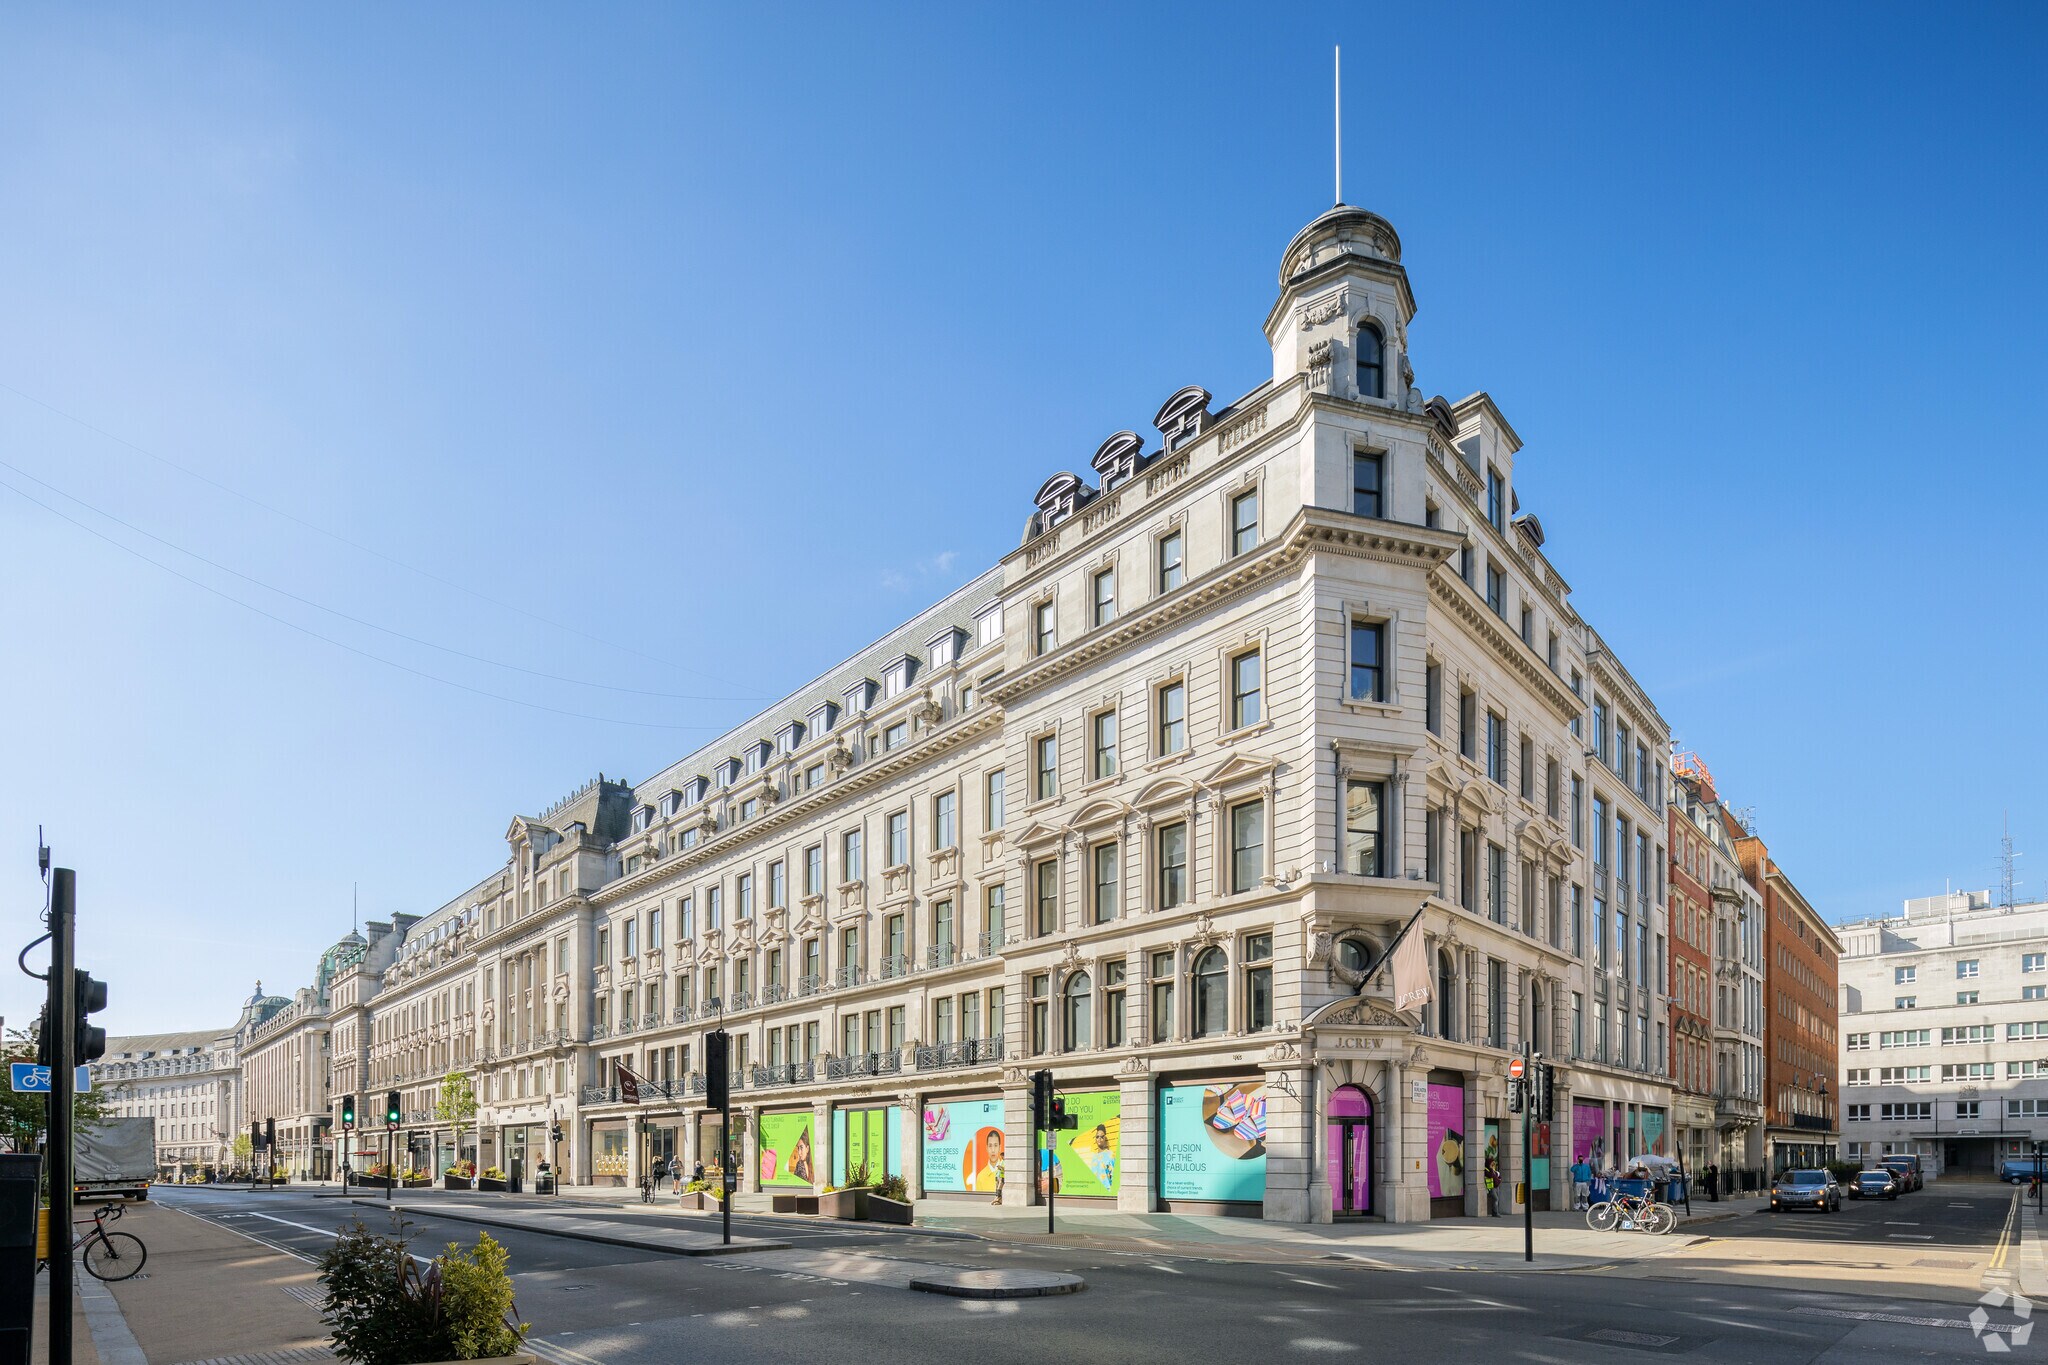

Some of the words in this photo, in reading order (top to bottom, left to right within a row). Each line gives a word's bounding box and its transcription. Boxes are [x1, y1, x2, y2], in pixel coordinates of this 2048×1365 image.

[1399, 986, 1430, 1007] J.CREW
[1335, 1037, 1384, 1049] J.CREW
[1080, 1105, 1093, 1113] YOU
[943, 1147, 959, 1155] DRESS
[1166, 1144, 1171, 1152] A
[1173, 1144, 1201, 1152] FUSION
[1166, 1153, 1176, 1162] OF
[1177, 1153, 1193, 1162] THE
[1166, 1163, 1207, 1171] FABULOUS
